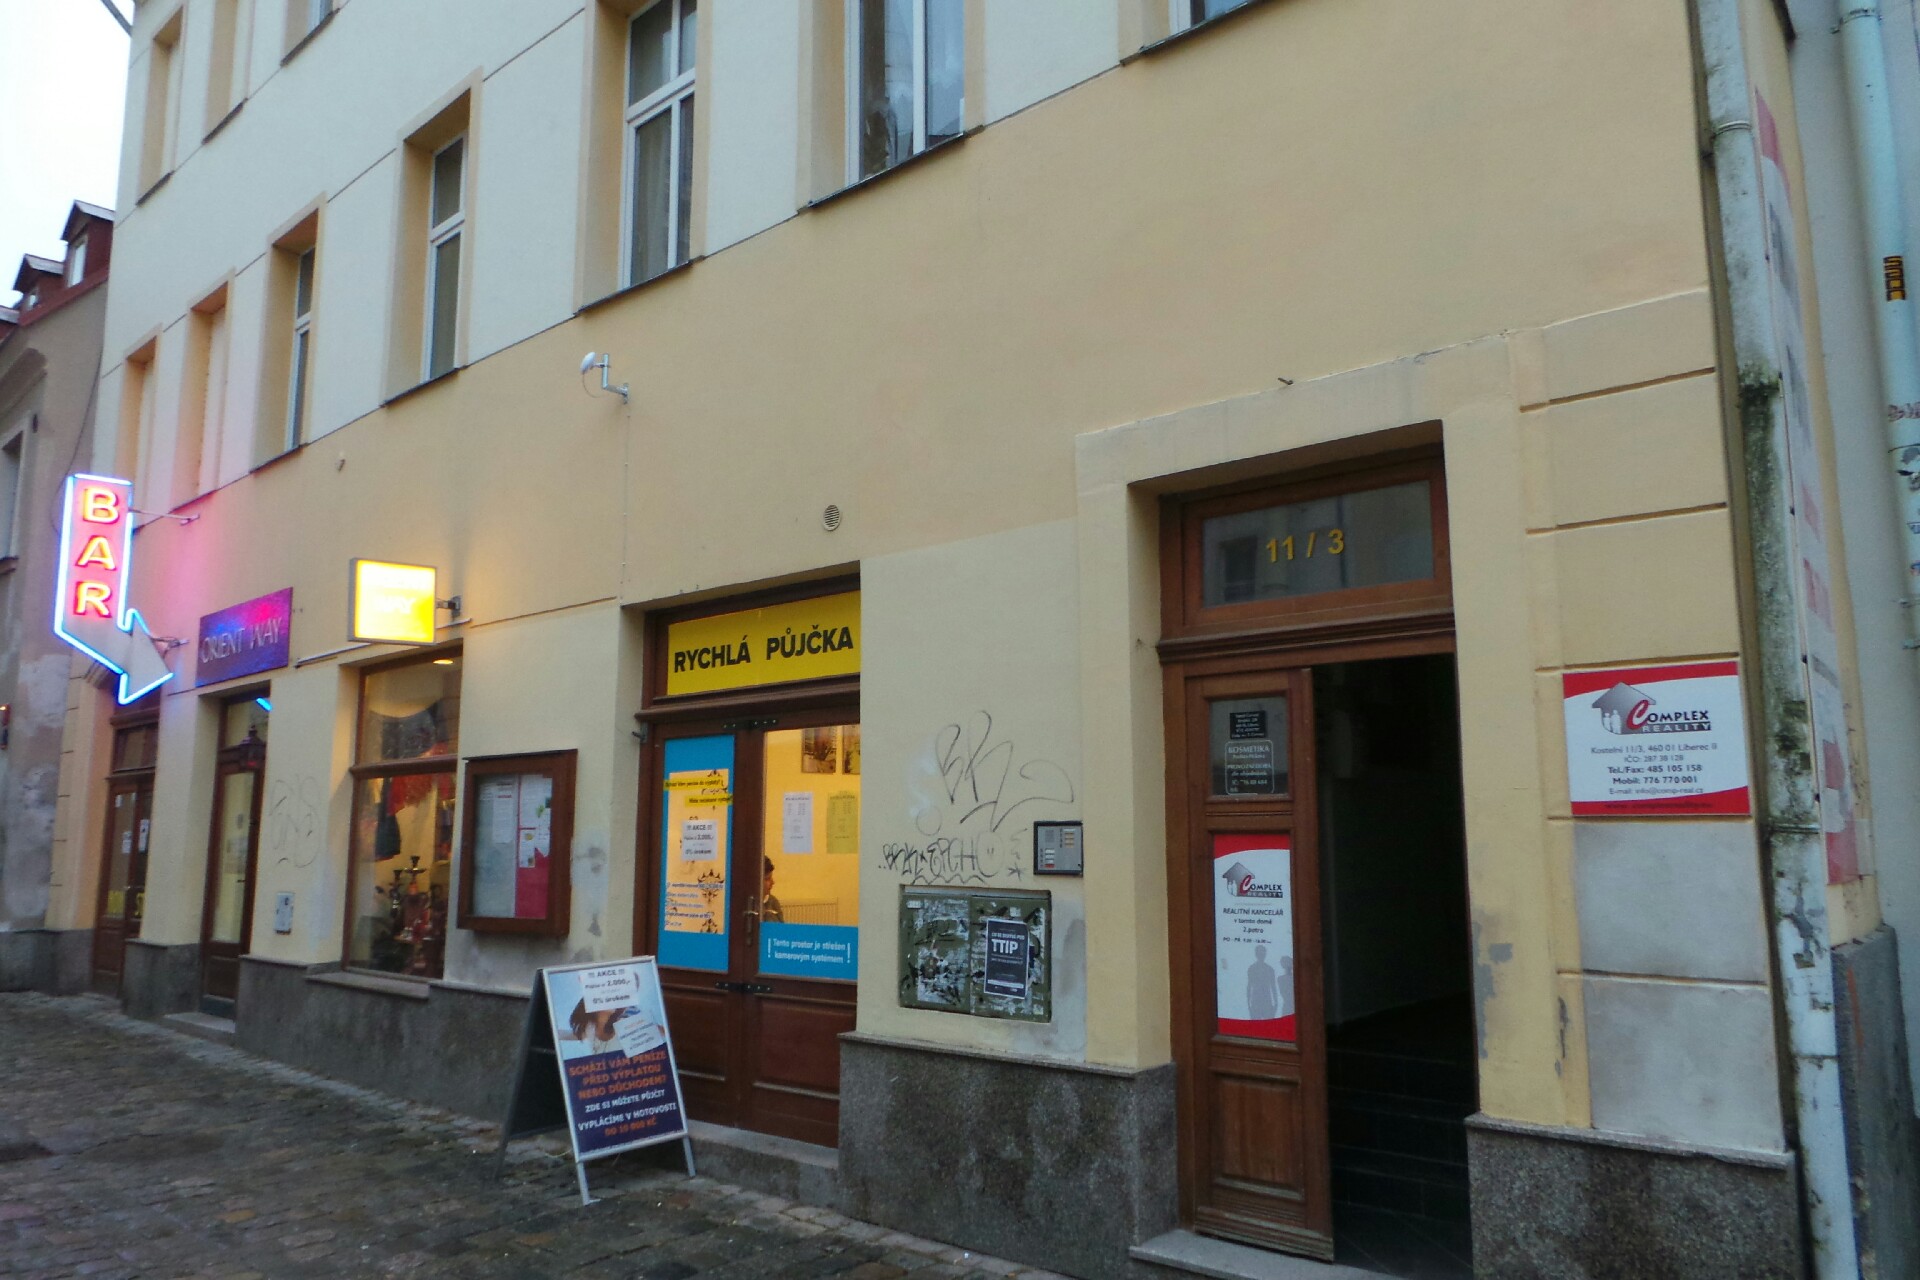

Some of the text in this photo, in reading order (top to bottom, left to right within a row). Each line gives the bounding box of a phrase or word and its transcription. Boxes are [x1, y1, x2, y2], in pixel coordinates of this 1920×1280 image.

[73, 486, 120, 618] BAR
[201, 616, 282, 663] ORIENT WAY
[674, 625, 853, 673] RYCHLÁ PŮJČKA
[1627, 699, 1709, 730] COMPLEX
[1643, 723, 1711, 733] REALITY
[1678, 743, 1709, 751] Liberec
[1646, 765, 1663, 773] 485
[1686, 764, 1703, 772] 158
[1613, 775, 1697, 785] Mobil: 776 770 001
[1239, 874, 1282, 895] COMPLEX
[1223, 907, 1250, 915] REALITNÍ
[991, 938, 1018, 954] TTIP
[568, 1060, 606, 1076] SCHÁZÍ
[609, 1055, 631, 1069] VÁM
[583, 1064, 661, 1086] PŘED VÝPLATOU
[577, 1086, 606, 1099] NEBO
[585, 1103, 601, 1113] ZDE
[602, 1100, 611, 1108] SI
[612, 1094, 640, 1107] MŮŽETE
[578, 1114, 624, 1131] VYPLÁCÍME
[633, 1102, 677, 1118] HOTOVOSTI
